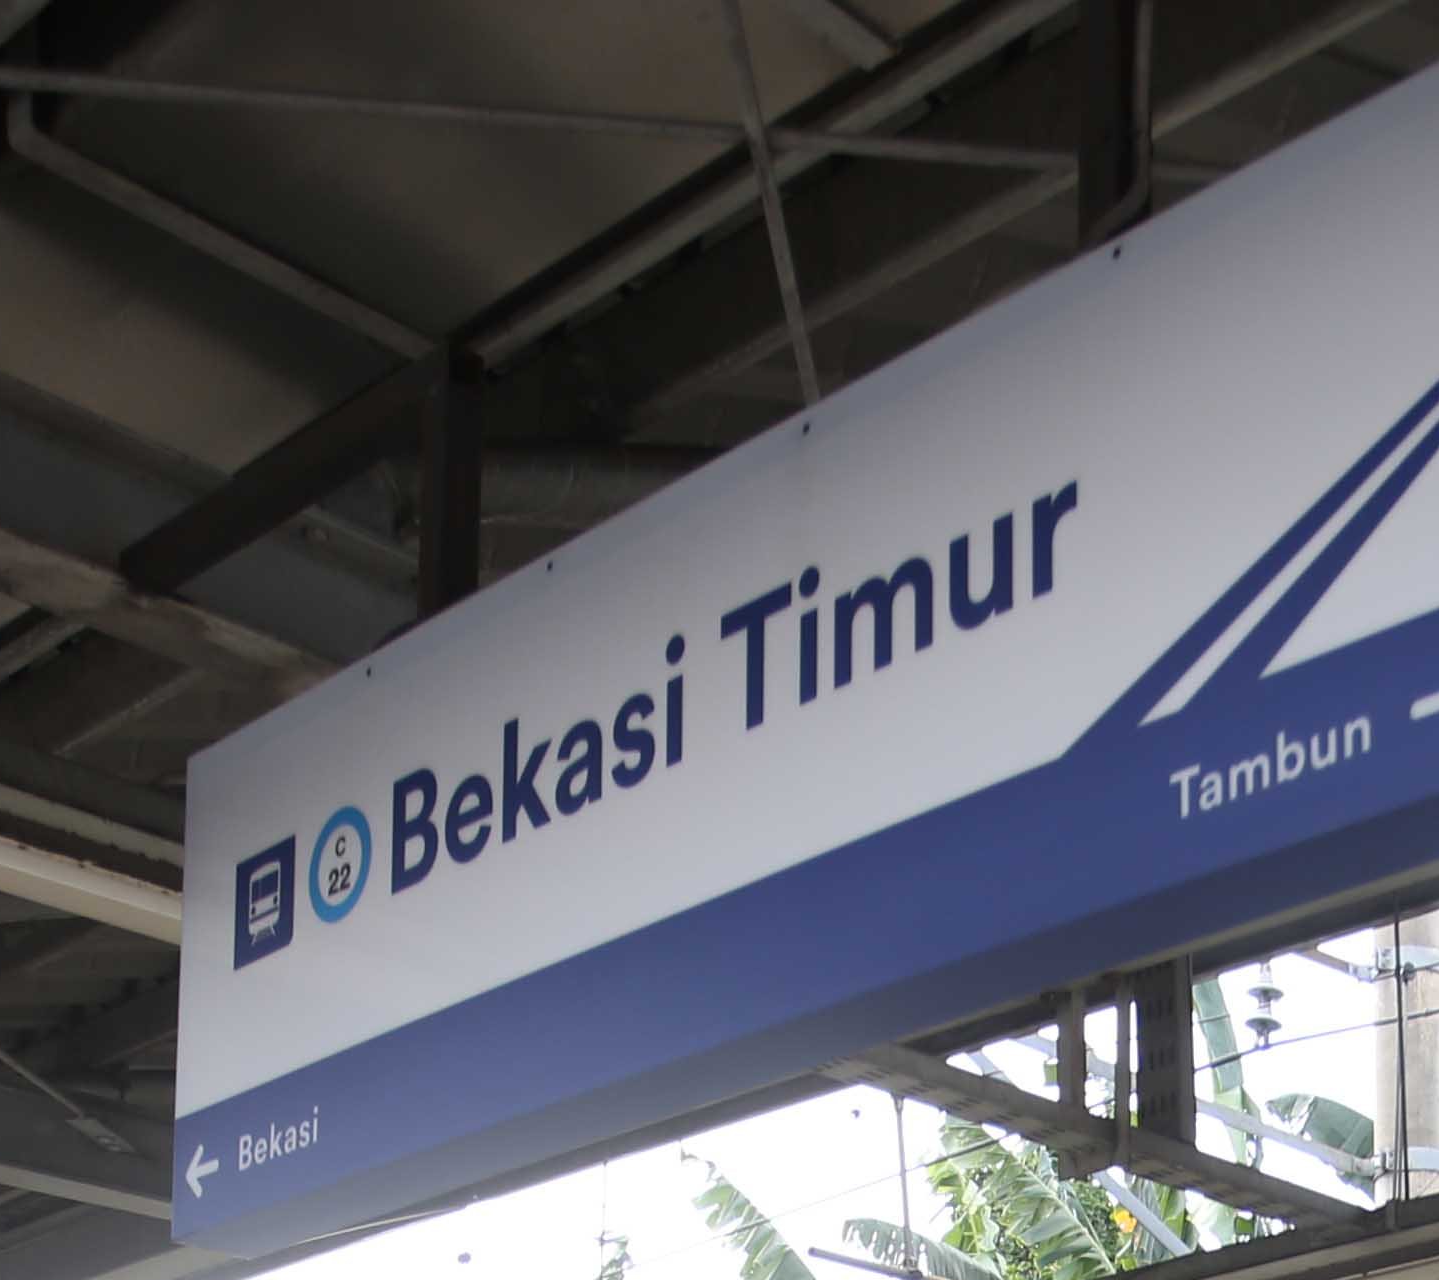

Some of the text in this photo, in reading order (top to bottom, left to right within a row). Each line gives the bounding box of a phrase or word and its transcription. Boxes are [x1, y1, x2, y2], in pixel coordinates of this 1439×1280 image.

[389, 480, 1079, 896] Bekasi Timur
[1170, 713, 1373, 819] Tambun
[334, 835, 347, 858] C
[327, 862, 353, 897] 22
[237, 1107, 320, 1171] Bekasi
